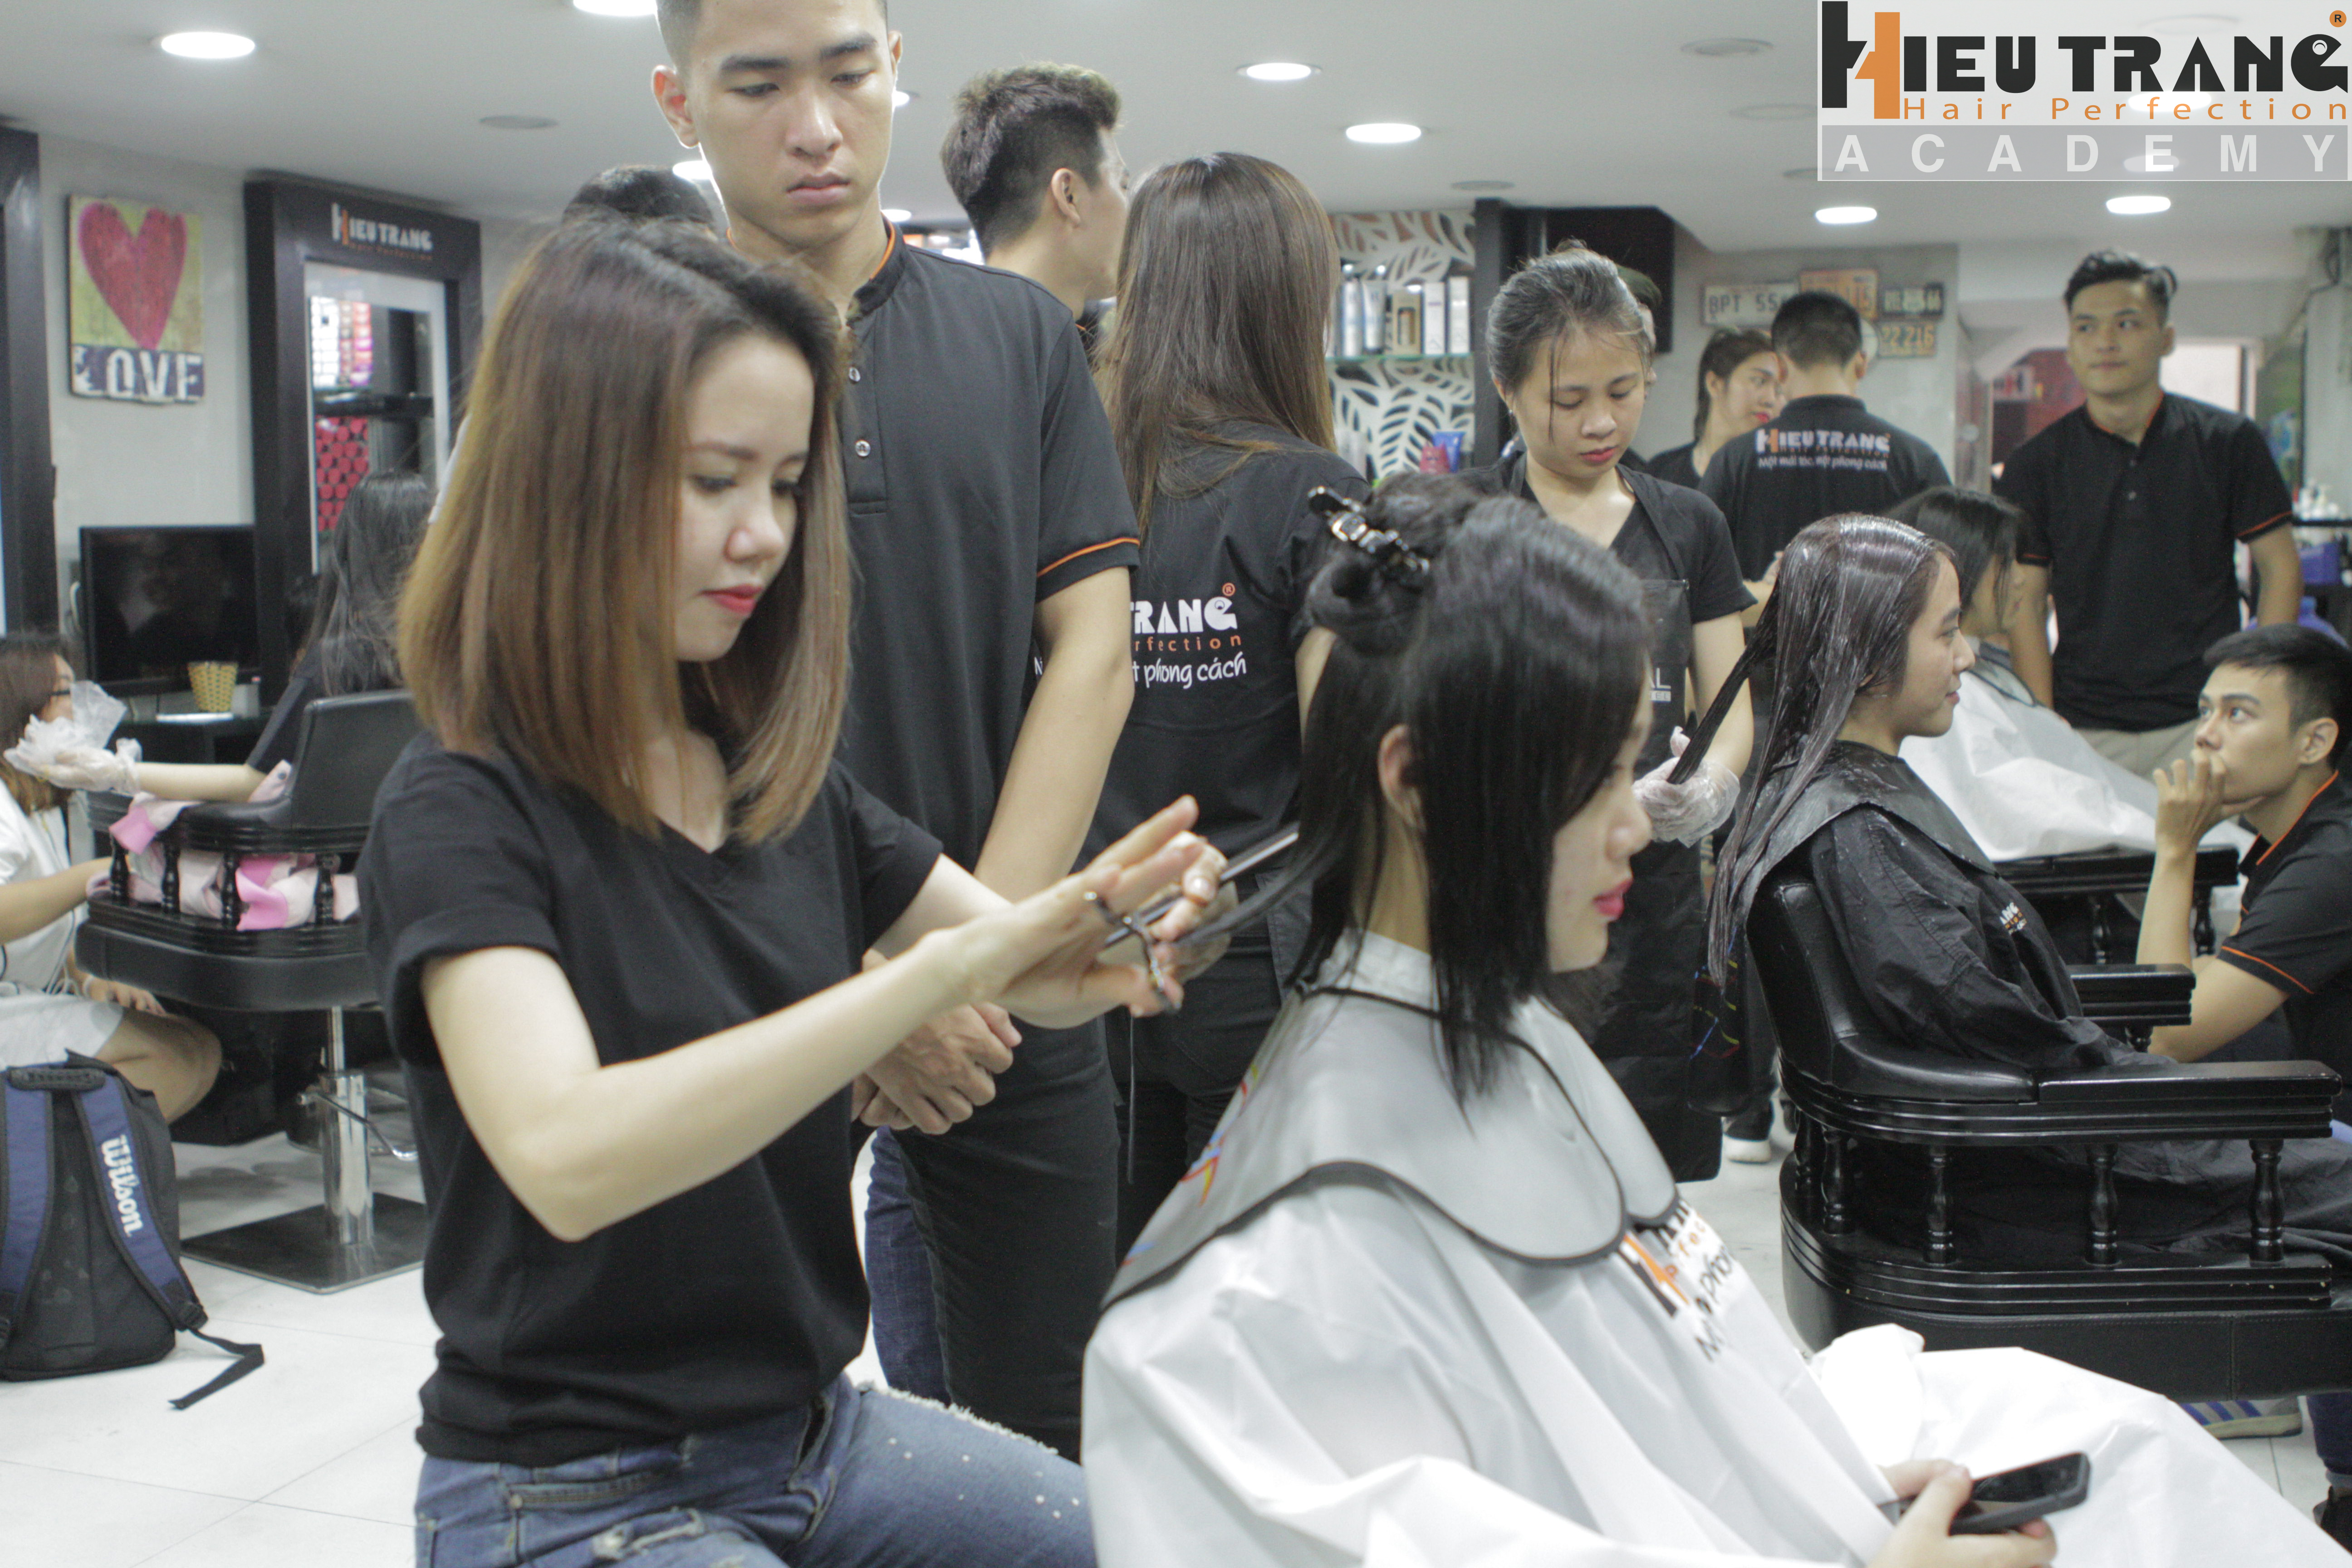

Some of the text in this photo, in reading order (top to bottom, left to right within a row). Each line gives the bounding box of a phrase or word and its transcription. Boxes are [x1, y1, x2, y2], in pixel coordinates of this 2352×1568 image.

[1756, 429, 1890, 454] HIEU TRANG
[1134, 635, 1241, 652] rfection
[1144, 658, 1192, 689] phong
[1197, 651, 1246, 681] cách
[101, 1134, 143, 1238] Wilson
